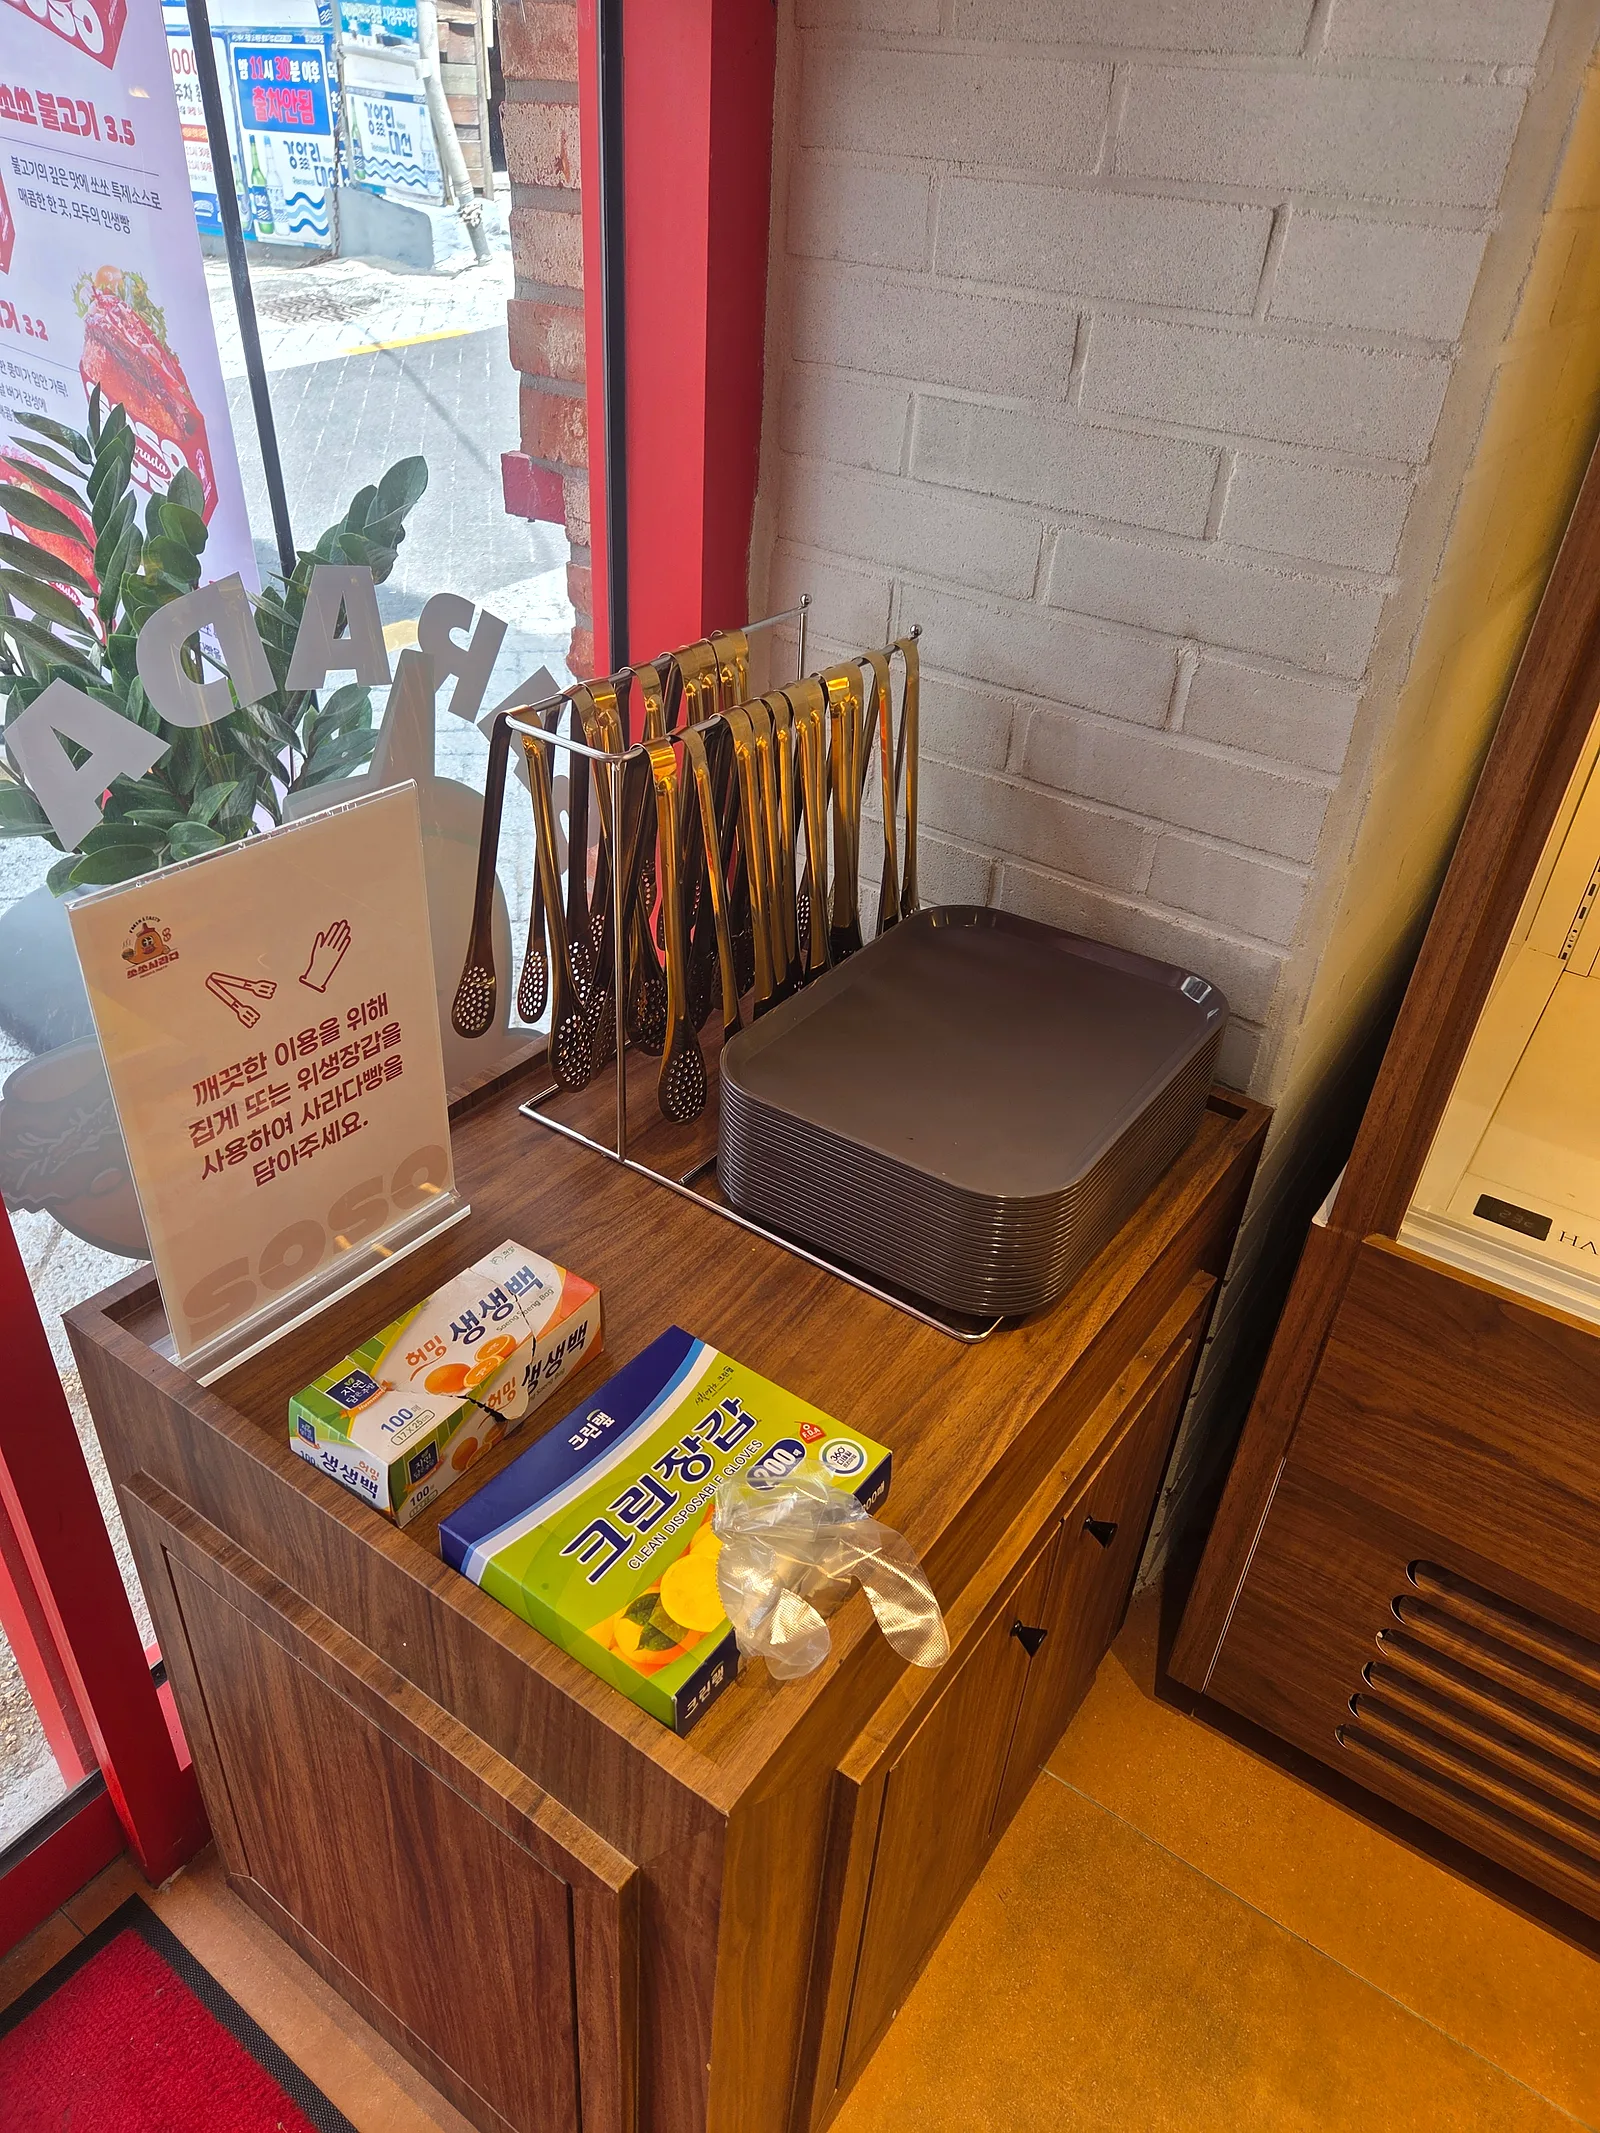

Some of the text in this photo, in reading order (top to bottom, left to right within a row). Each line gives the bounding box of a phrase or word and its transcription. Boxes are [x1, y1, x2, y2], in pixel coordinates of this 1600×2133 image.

[35, 89, 101, 141] 불고기
[103, 115, 136, 146] 3.5
[252, 86, 315, 125] 출차안됨
[11, 155, 163, 210] 불고기의 깊은 맛에 쏘쏘 특제소스로
[17, 187, 47, 211] 매콤한
[47, 194, 58, 214] 한
[71, 201, 101, 226] 모두의
[101, 208, 131, 235] 인생빵
[22, 314, 49, 341] 3.2
[5, 385, 23, 404] 버거
[22, 391, 48, 413] 감성에
[7, 361, 32, 384] 풍미가
[31, 371, 49, 391] 입안
[48, 378, 69, 397] 가득!
[192, 992, 389, 1107] 깨끗한 이용을 위해
[188, 1021, 402, 1149] 집게 또는 위생장갑을
[201, 1054, 404, 1181] 사용하여 사라다빵을
[252, 1111, 369, 1187] 담아주세요.
[183, 1145, 449, 1344] SOSO
[405, 1265, 544, 1372] 허밍 생생백
[538, 1288, 555, 1302] Bag
[340, 1379, 367, 1397] 자연
[488, 1320, 588, 1408] 허밍 생생백
[567, 1408, 616, 1451] 크린랩
[319, 1451, 379, 1500] 생생백
[353, 1460, 380, 1482] 허밍
[559, 1397, 758, 1585] 크린장갑
[627, 1439, 763, 1570] CLEAN DISPOSABLE GLOVES
[684, 1660, 724, 1719] 크린랩
